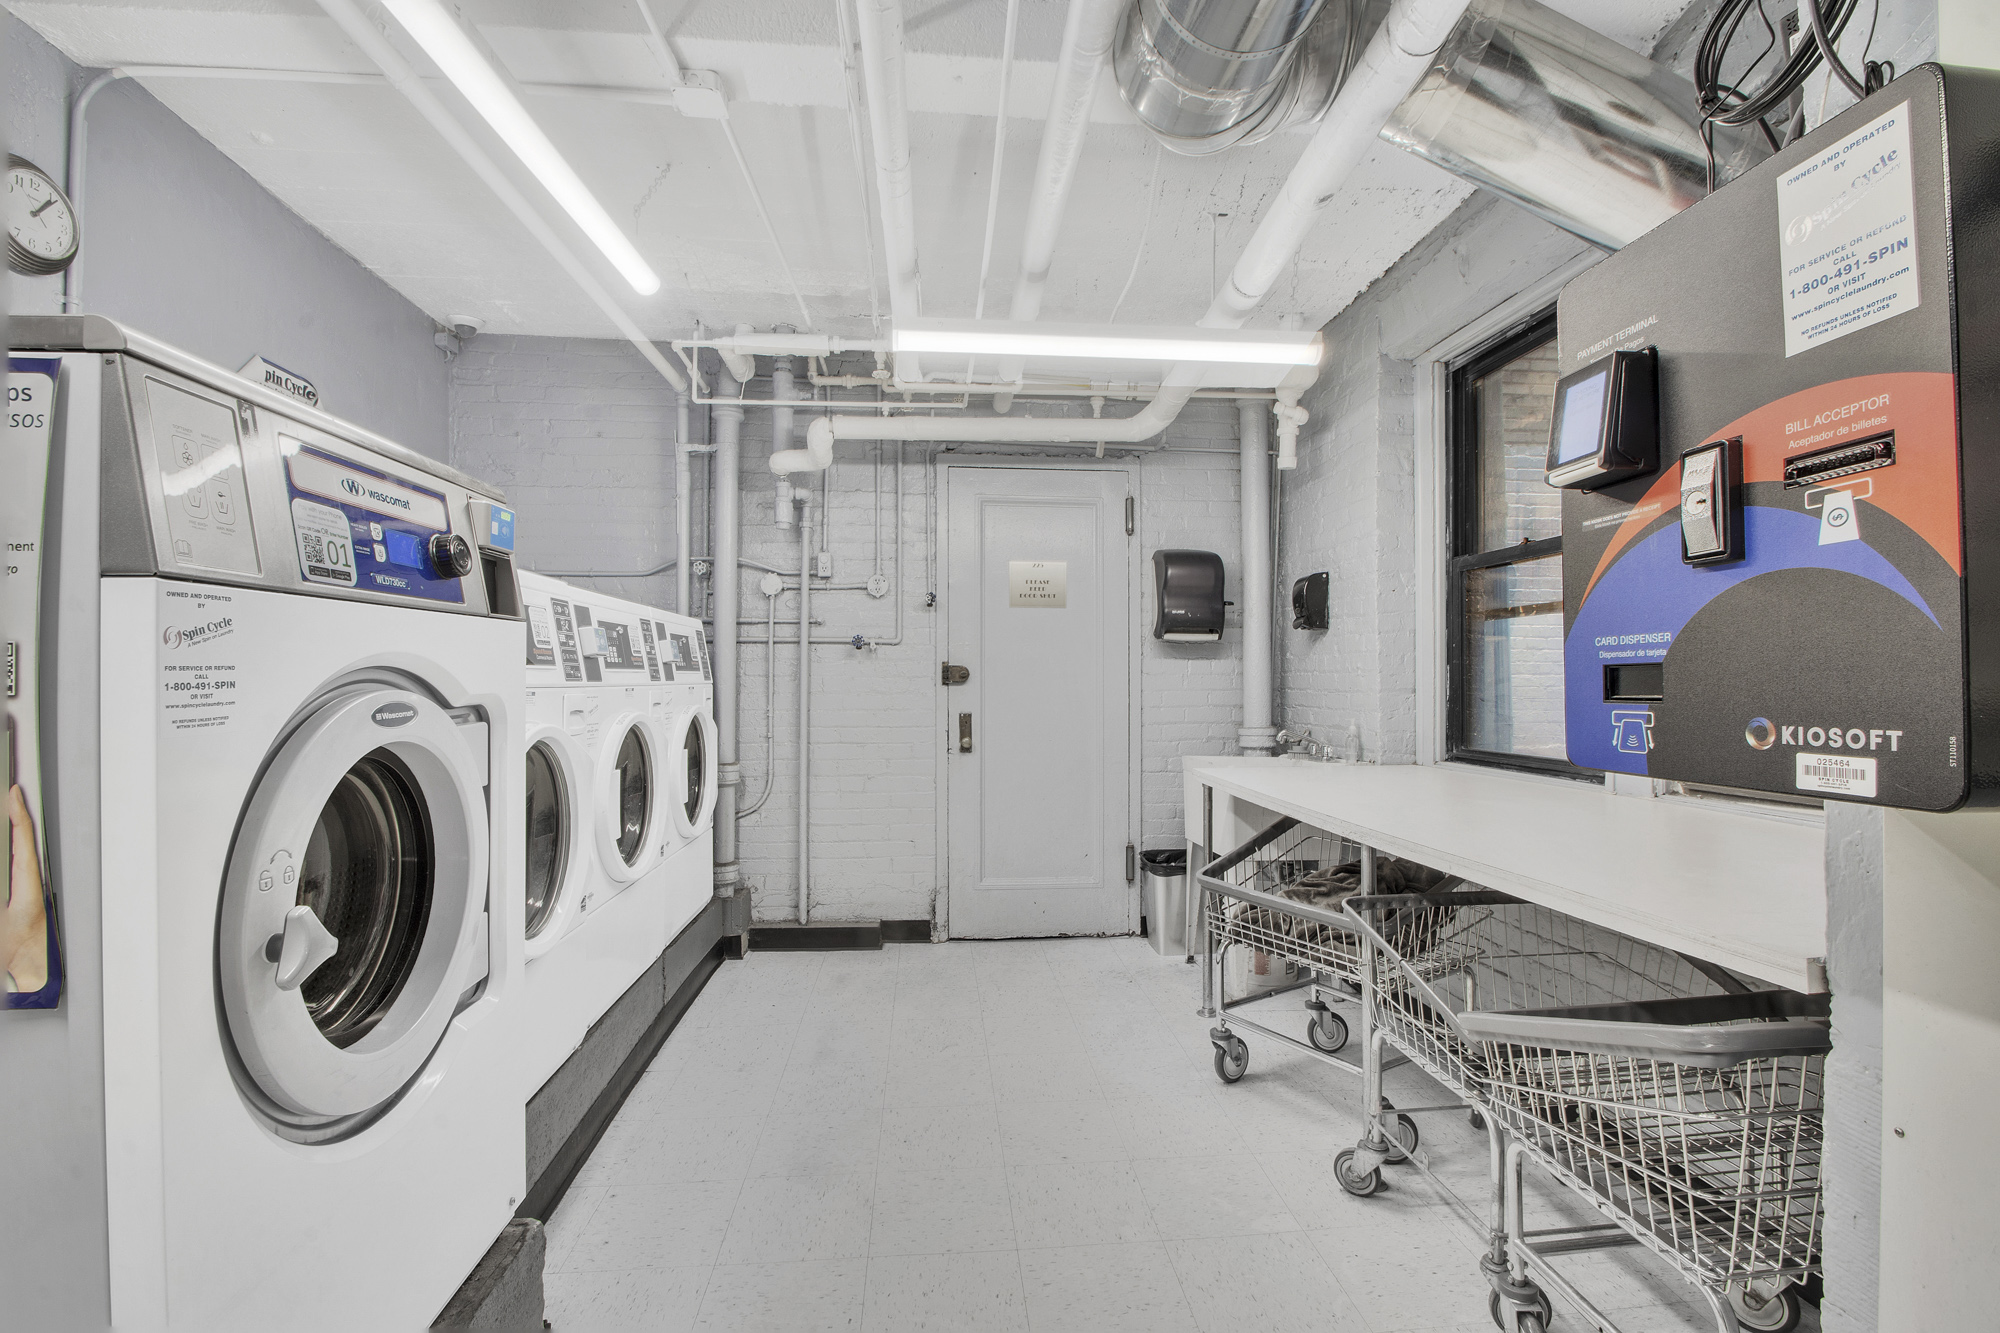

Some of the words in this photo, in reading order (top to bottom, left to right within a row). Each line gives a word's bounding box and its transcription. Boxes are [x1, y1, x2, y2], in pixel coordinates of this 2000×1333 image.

[1787, 164, 1818, 186] OWNED
[1821, 152, 1840, 167] AND
[1843, 119, 1895, 153] OPERATED
[1833, 160, 1846, 172] BY
[1851, 149, 1898, 189] Cycle
[30, 178, 40, 192] 12
[57, 209, 64, 220] 2
[14, 226, 21, 239] 7
[61, 224, 68, 236] 3
[28, 237, 36, 250] 6
[45, 241, 52, 253] 5
[56, 236, 63, 248] 4
[1788, 264, 1806, 276] FOR
[1808, 243, 1847, 267] SERVICE
[1850, 236, 1863, 247] OR
[1866, 214, 1907, 240] REFUND
[1833, 250, 1857, 266] CALL
[1789, 237, 1908, 300] 1-800-491-SPIN
[1827, 284, 1840, 295] OR
[1842, 272, 1866, 288] VISIT
[1791, 266, 1910, 321] www.spincyclelaundry.com
[1801, 328, 1809, 336] NO
[1811, 317, 1839, 332] REFUNDS
[1840, 306, 1865, 320] UNLESS
[1866, 292, 1898, 309] NOTIFIED
[1808, 327, 1829, 340] WITHIN
[1831, 323, 1838, 332] 24
[1839, 315, 1861, 328] HOURS
[1863, 310, 1871, 318] OF
[1873, 303, 1890, 315] LOSS
[1577, 335, 1614, 361] PAYMENT
[1615, 314, 1659, 341] TERMINAL
[1624, 336, 1645, 351] Pagos
[285, 377, 317, 400] Cycle
[1785, 418, 1811, 435] BILL
[1813, 393, 1890, 427] ACCEPTOR
[1788, 429, 1835, 450] Aceptador
[1836, 426, 1849, 436] de
[1851, 415, 1887, 432] billetes
[367, 488, 411, 510] wascomat
[327, 540, 351, 568] 01
[375, 574, 406, 588] WLD730cc
[166, 590, 189, 598] OWNED
[203, 594, 232, 602] OPERATED
[182, 626, 206, 641] Spin
[207, 617, 233, 632] Cycle
[218, 629, 234, 637] Laundry
[1595, 636, 1618, 646] CARD
[1620, 632, 1671, 645] DISPENSER
[1599, 649, 1636, 659] Dispensador
[1646, 649, 1667, 657] tarjeta
[165, 681, 236, 691] 1-800-491-SPIN
[165, 701, 236, 709] www.spincyclelaundry.com
[382, 710, 414, 719] Wascomat
[1781, 725, 1902, 752] KIOSOFT
[1816, 758, 1850, 767] 025464
